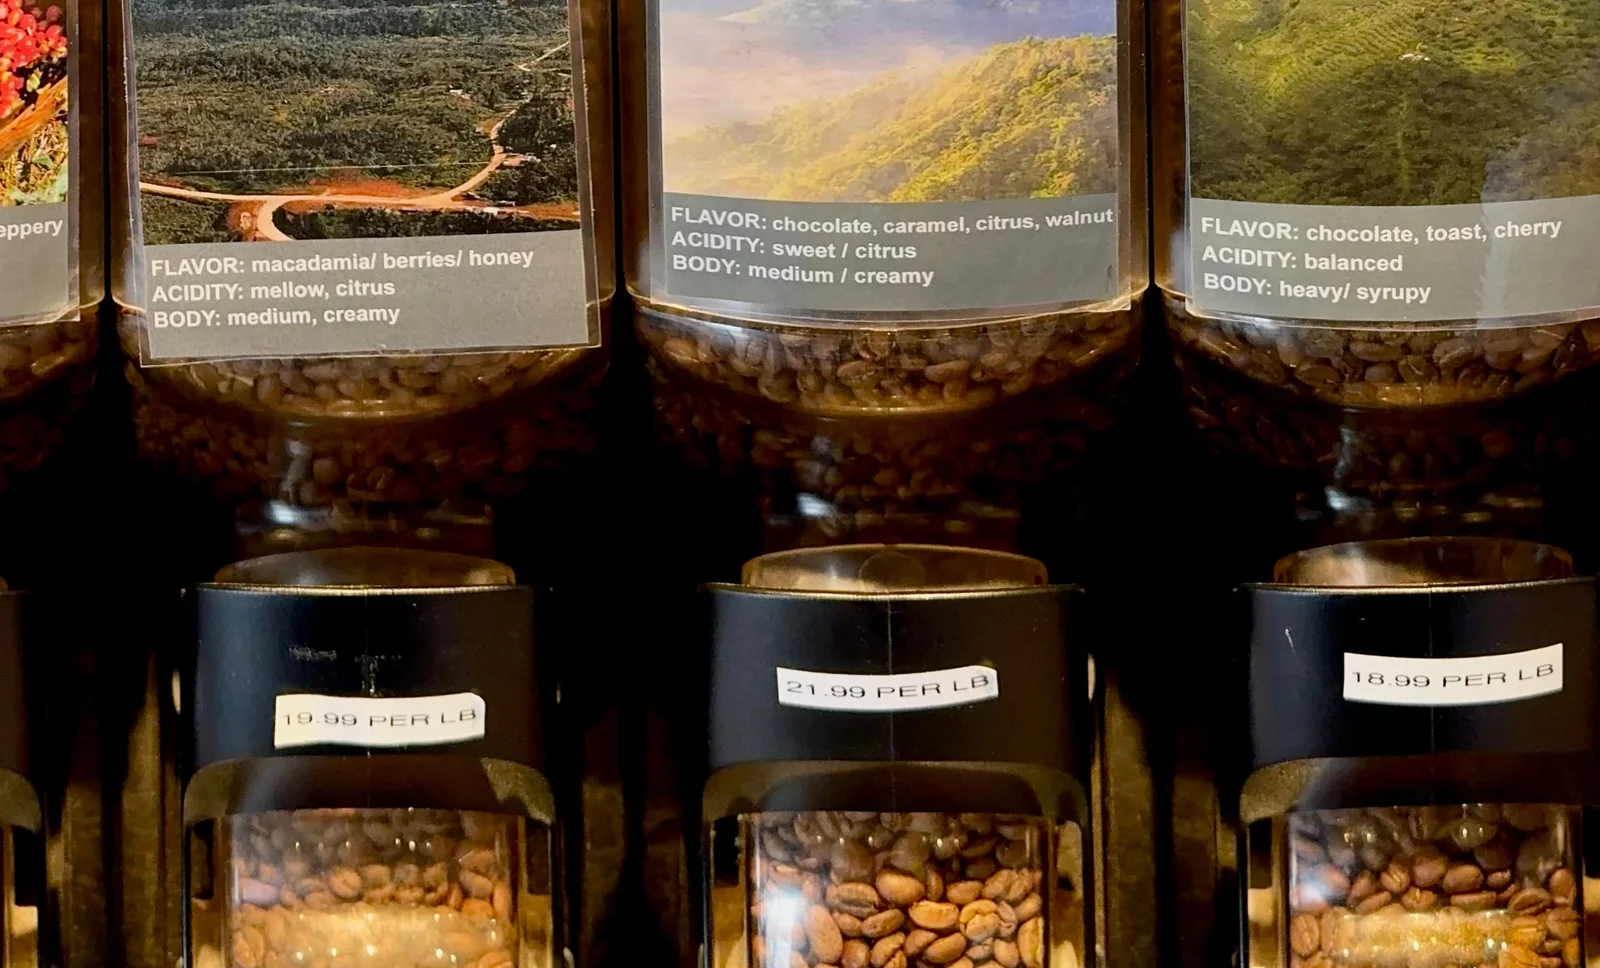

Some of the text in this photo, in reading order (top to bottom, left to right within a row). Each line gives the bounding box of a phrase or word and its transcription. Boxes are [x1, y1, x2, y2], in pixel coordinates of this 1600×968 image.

[671, 207, 1113, 236] FLAVOR: chocolate, caramel, citrus, walnut
[1202, 217, 1562, 244] FLAVOR: chocolate, toast, cherry
[672, 231, 765, 256] ACIDITY:
[772, 244, 836, 258] sweet
[855, 243, 916, 258] citrus
[151, 250, 534, 276] FLAVOR: macadamia/ berries/ honey
[673, 255, 741, 275] BODY:
[748, 265, 834, 283] medium
[854, 268, 934, 287] creamy
[1202, 246, 1402, 271] ACIDITY: balanced
[153, 280, 395, 302] ACIDITY: mellow, citrus
[1204, 273, 1431, 304] BODY: heavy/ syrupy
[154, 306, 400, 328] BODY: medium, creamy
[787, 675, 989, 698] 21.99 PER LB
[1352, 663, 1553, 687] 18.99 PER LB
[282, 709, 476, 727] 19.99 PER LB
